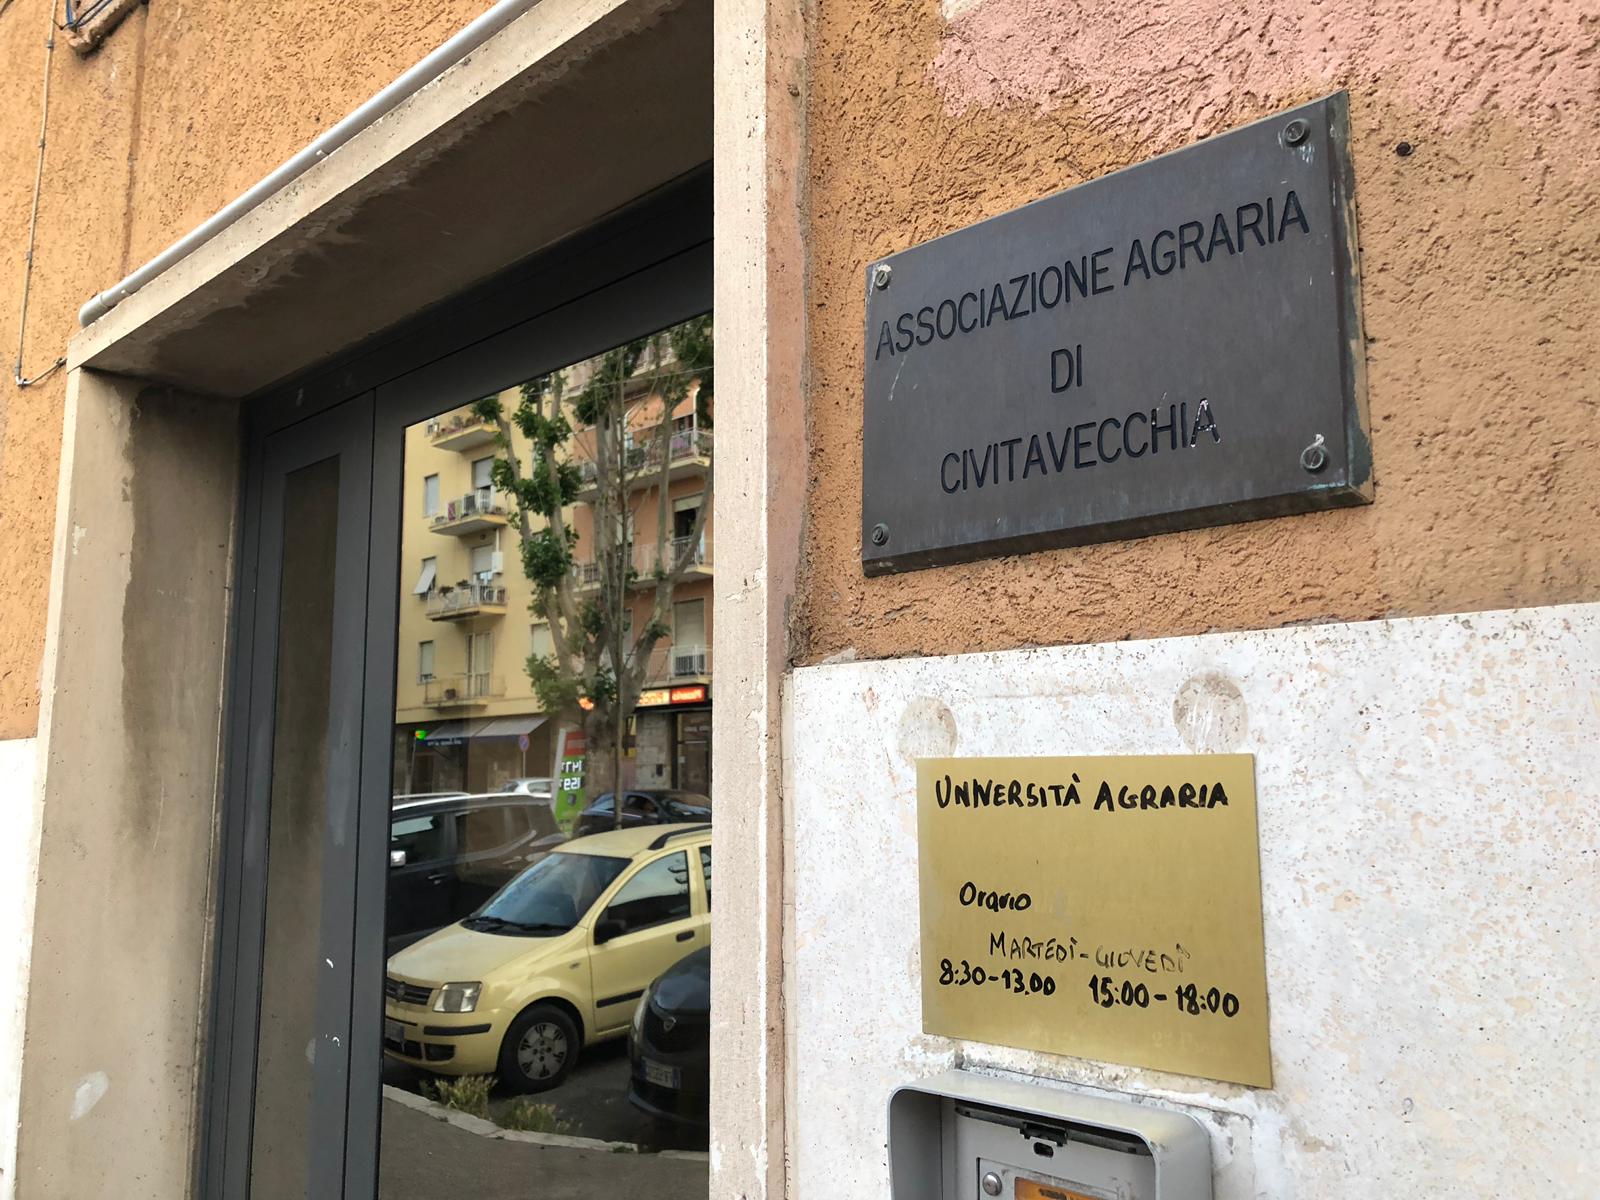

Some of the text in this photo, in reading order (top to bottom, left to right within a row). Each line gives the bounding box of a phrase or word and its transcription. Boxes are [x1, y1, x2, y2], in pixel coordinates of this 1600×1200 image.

[875, 190, 1310, 361] ASSOCIAZIONE AGRARIA
[1050, 344, 1083, 394] DI
[940, 397, 1222, 494] CIVITAVECCHIA
[1093, 780, 1229, 812] AGRARIA
[959, 881, 1032, 912] Orario
